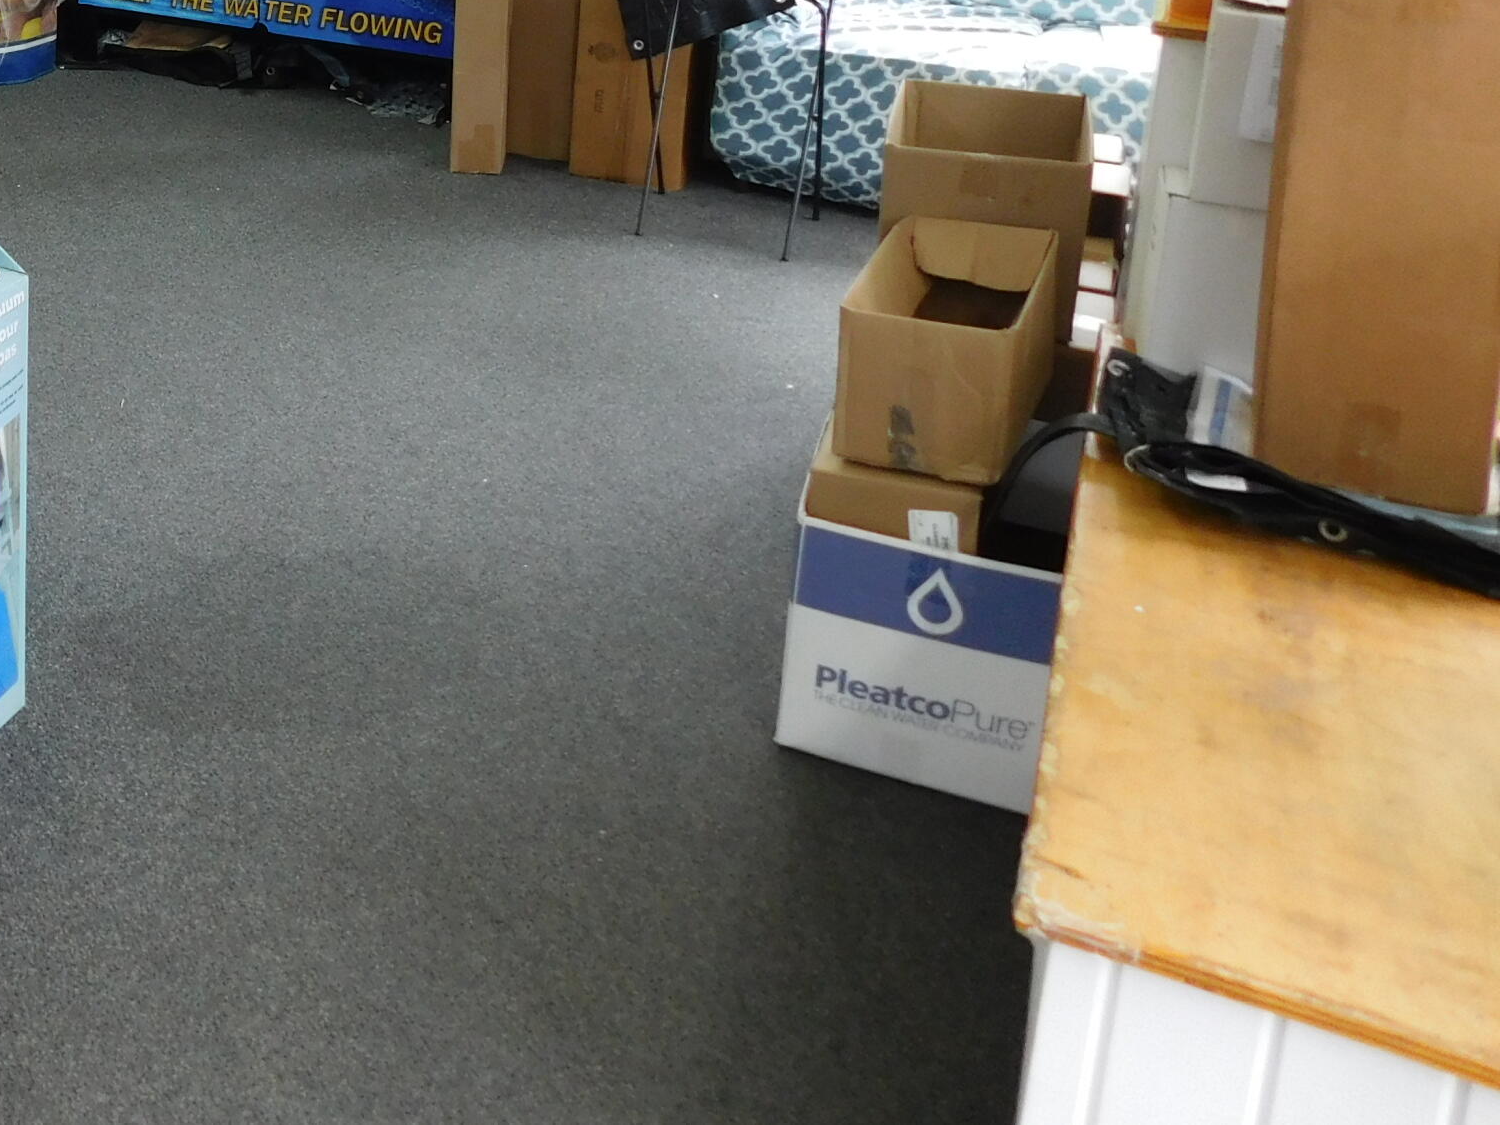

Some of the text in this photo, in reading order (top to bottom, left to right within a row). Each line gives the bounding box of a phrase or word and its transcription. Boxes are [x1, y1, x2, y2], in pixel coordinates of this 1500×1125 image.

[320, 8, 444, 44] FLOWING
[814, 690, 1025, 753] THE CLEAN WATER COMPANY
[815, 663, 1029, 741] PleatcoPure
